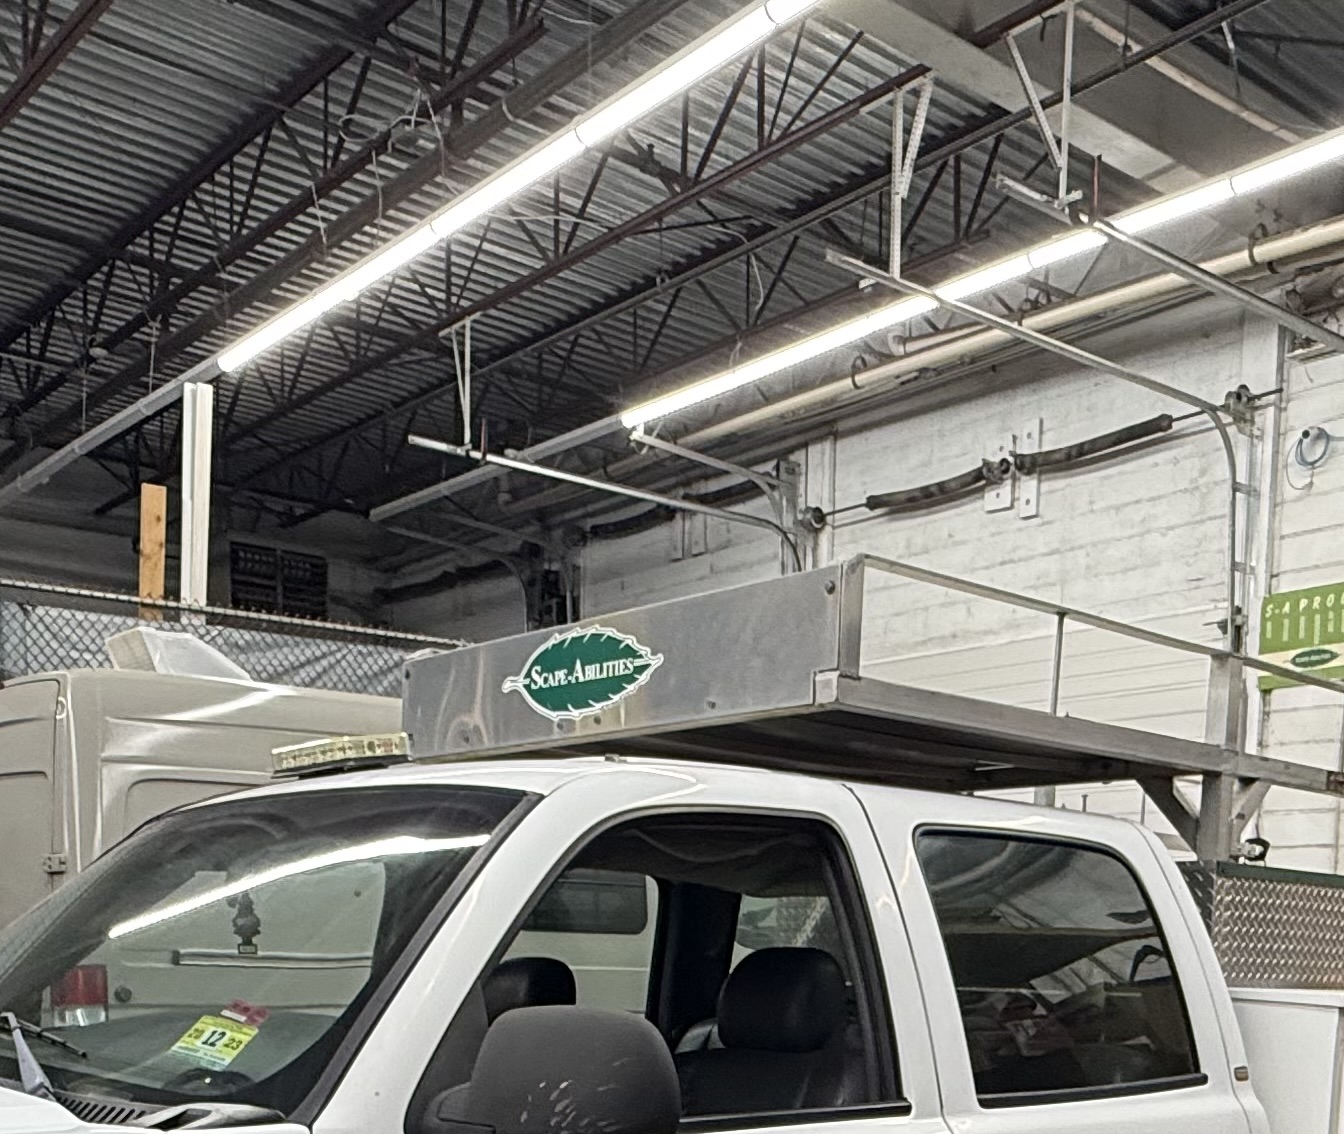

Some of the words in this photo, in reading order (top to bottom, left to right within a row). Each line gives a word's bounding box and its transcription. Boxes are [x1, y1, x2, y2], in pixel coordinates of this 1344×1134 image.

[530, 658, 635, 690] SCAPE-ABILITIES
[201, 1030, 227, 1048] 12
[223, 1038, 243, 1051] 23
